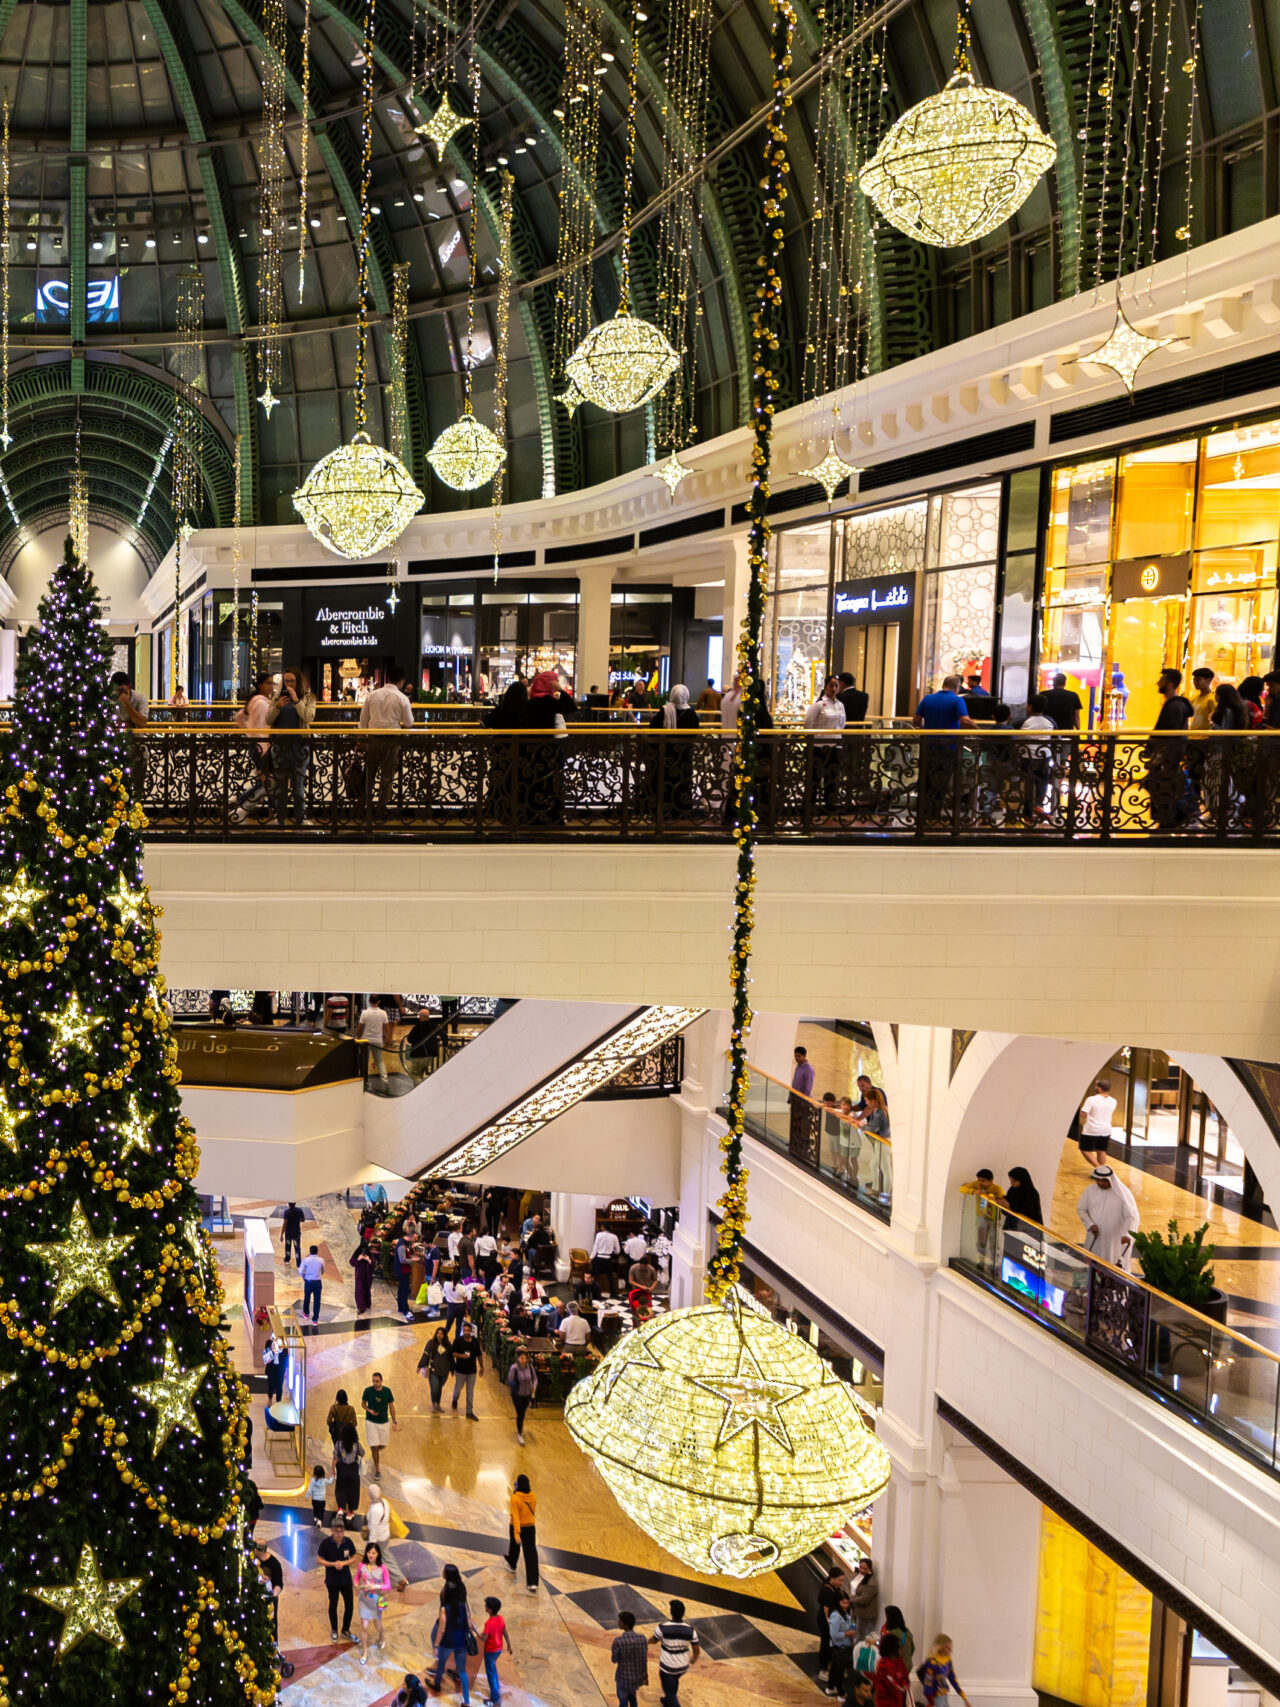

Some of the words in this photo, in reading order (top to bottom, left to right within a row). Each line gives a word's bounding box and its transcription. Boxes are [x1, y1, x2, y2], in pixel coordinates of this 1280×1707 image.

[315, 606, 385, 622] Abercrombie
[329, 624, 339, 635] &
[341, 620, 369, 634] Fitch
[320, 635, 362, 646] abercrombie
[362, 635, 378, 646] kids
[610, 1204, 630, 1212] PAUL
